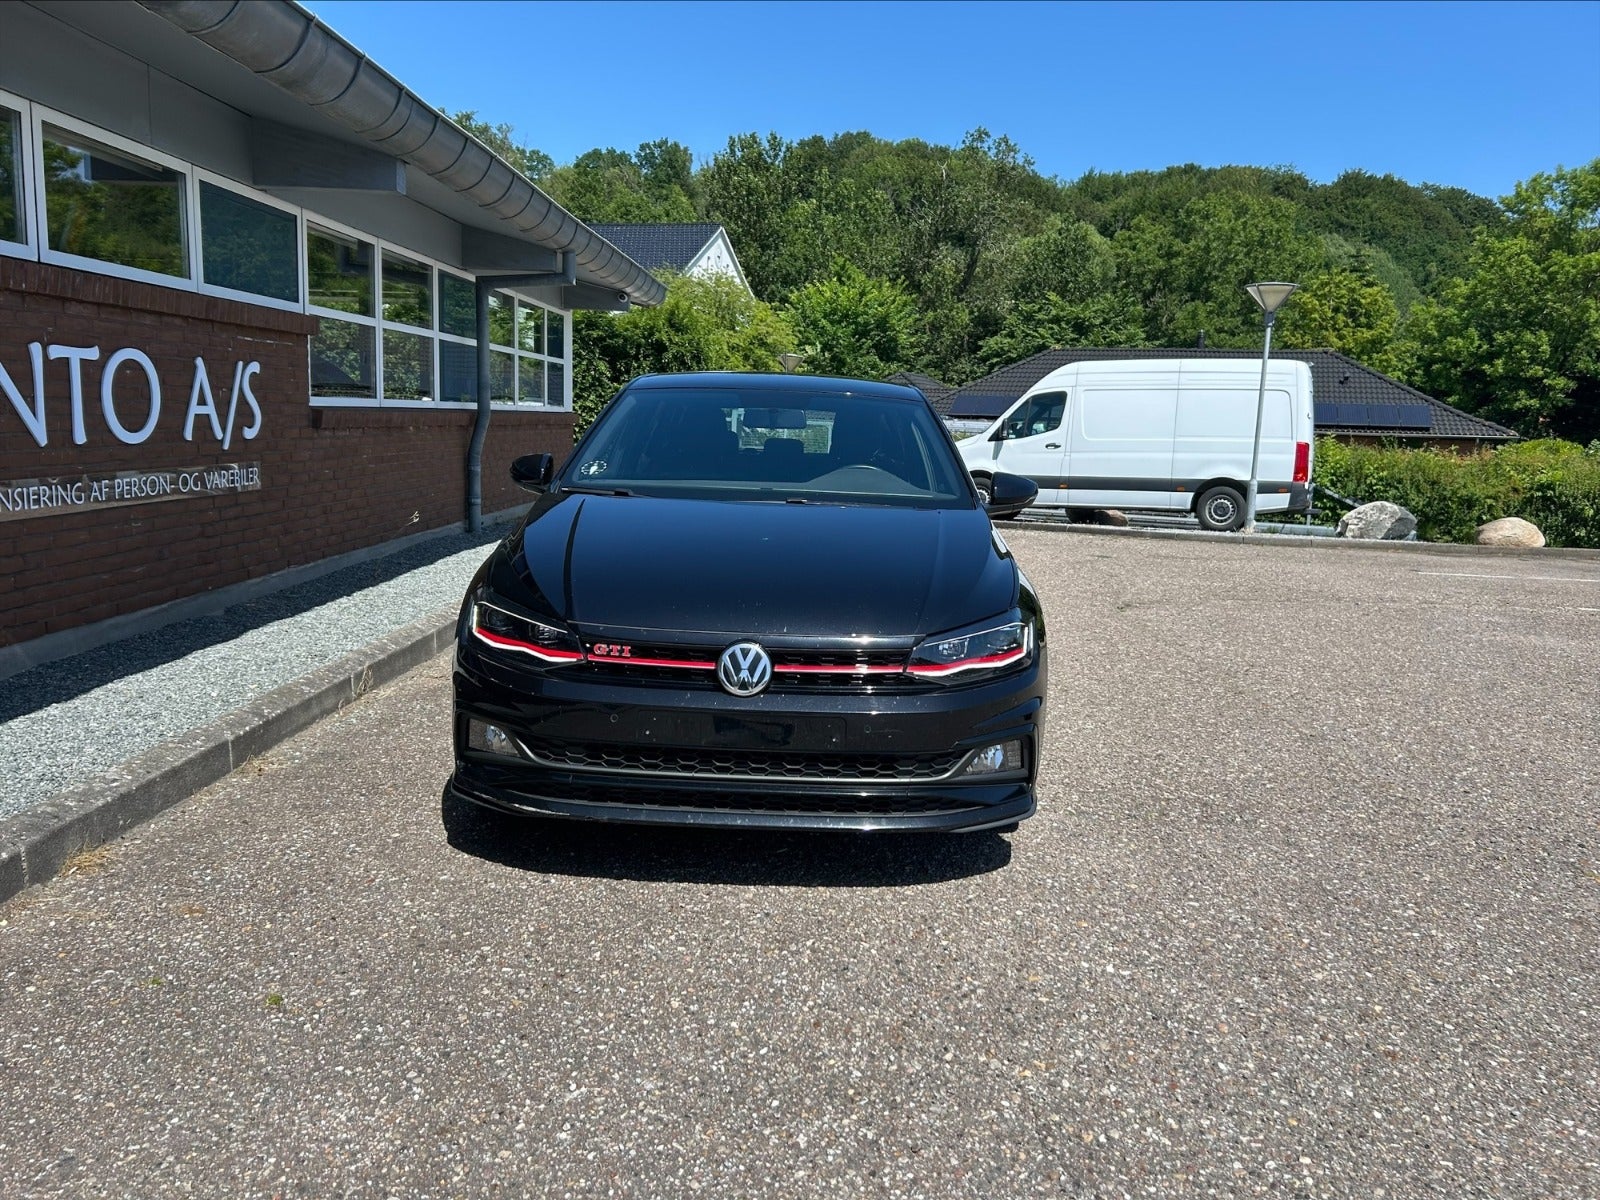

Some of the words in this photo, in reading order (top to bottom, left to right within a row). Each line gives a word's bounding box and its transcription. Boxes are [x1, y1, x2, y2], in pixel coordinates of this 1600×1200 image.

[183, 356, 262, 450] A/S
[90, 480, 110, 502] AF
[115, 474, 175, 499] PERSON-
[178, 472, 200, 492] OG
[204, 467, 260, 489] VAREBILER
[593, 643, 632, 657] GTI
